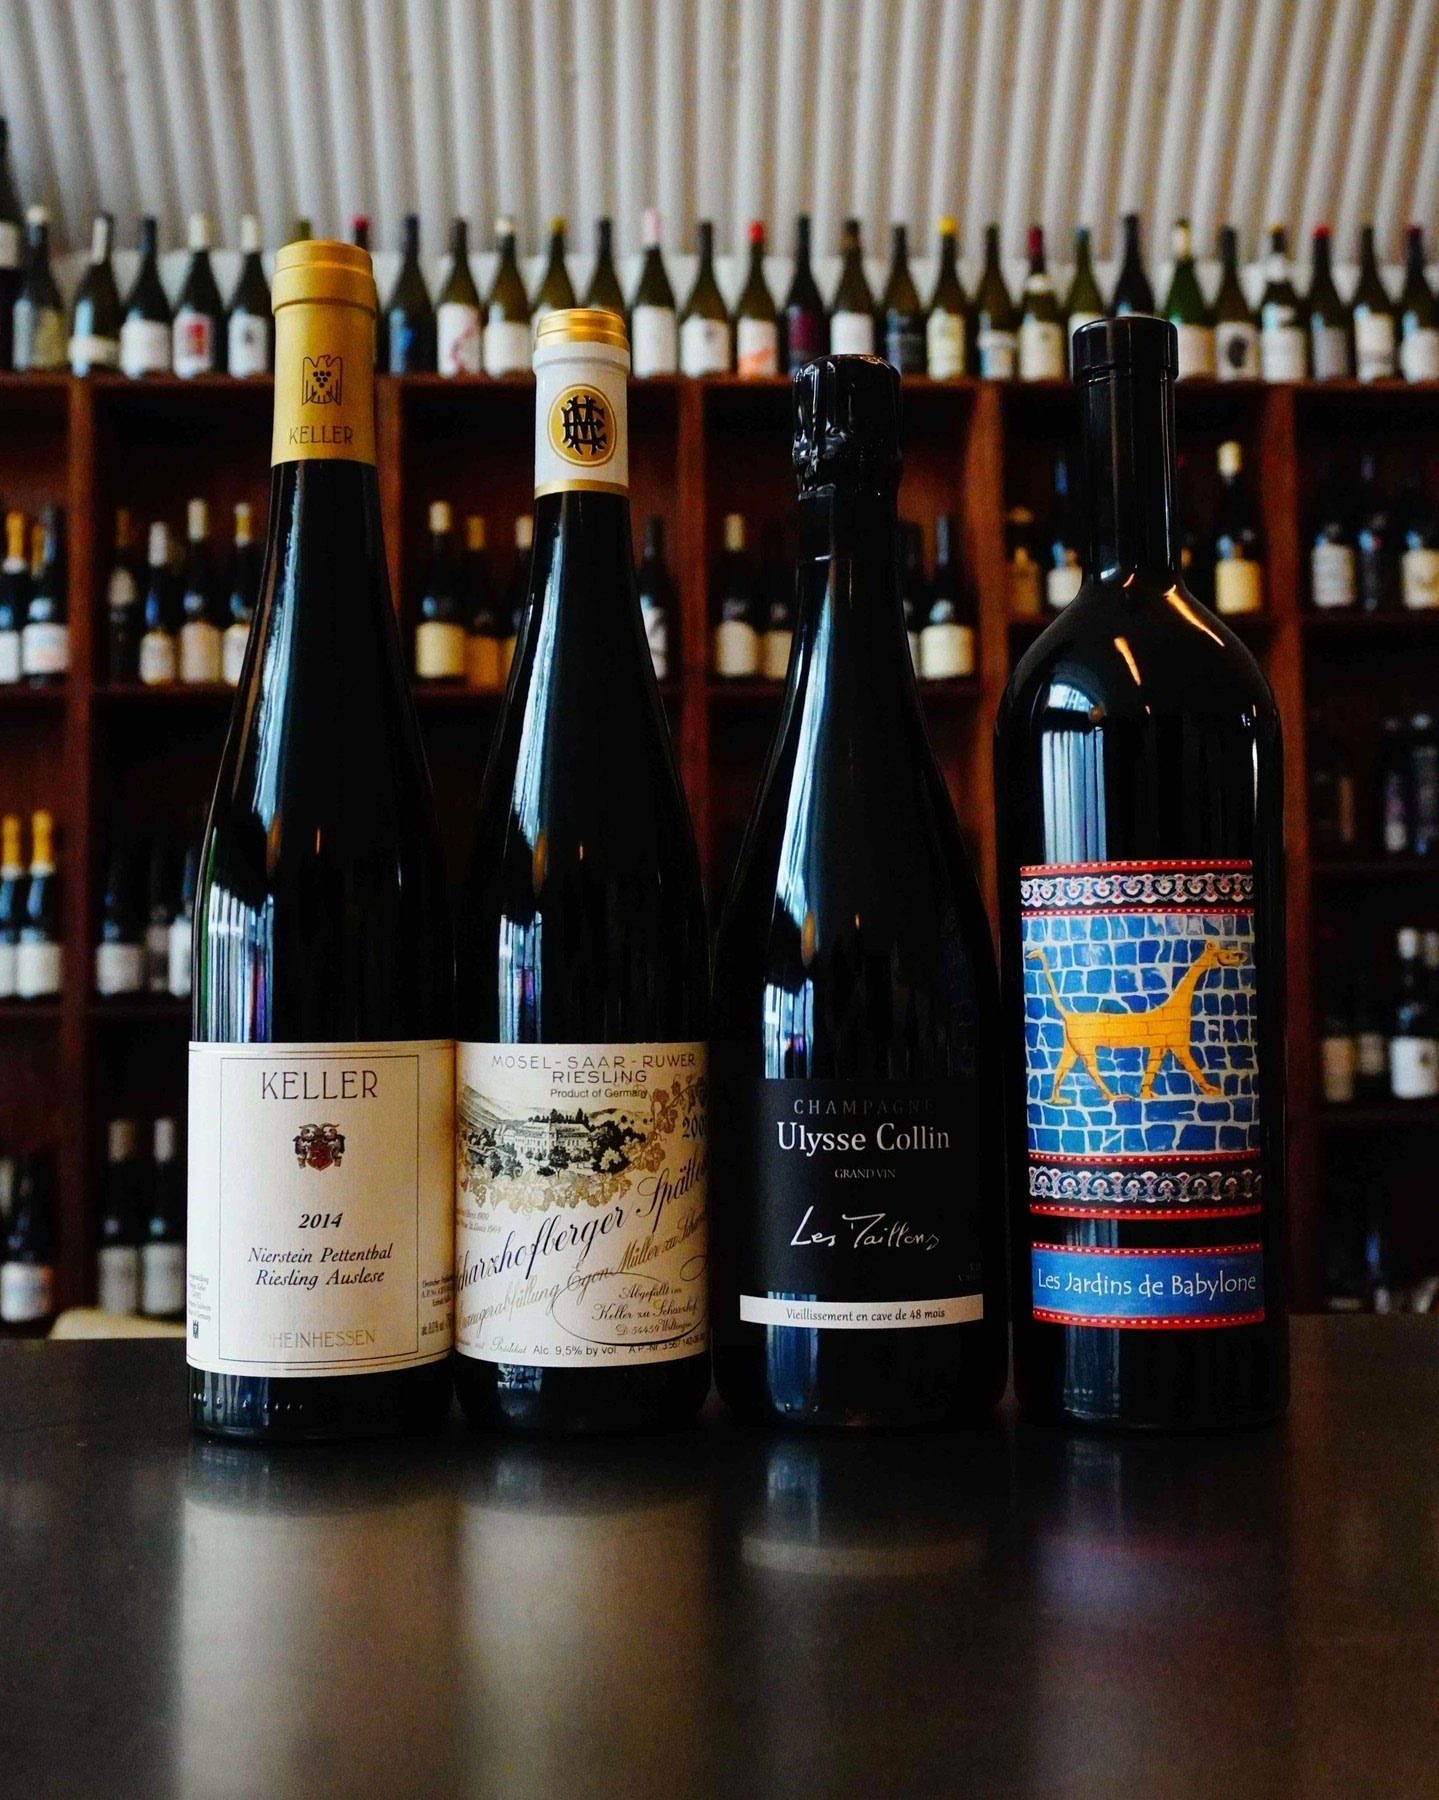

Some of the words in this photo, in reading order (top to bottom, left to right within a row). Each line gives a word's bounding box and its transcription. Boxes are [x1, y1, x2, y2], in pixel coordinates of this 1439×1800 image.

[288, 425, 353, 445] KELLER
[261, 1070, 378, 1100] KELLER
[552, 1070, 648, 1084] RIESLING
[550, 1088, 591, 1099] Product
[592, 1088, 602, 1099] of
[776, 1120, 867, 1157] Ulysse
[875, 1122, 951, 1151] Collin
[834, 1168, 875, 1179] GRAND
[876, 1168, 897, 1179] VIN
[298, 1212, 343, 1230] 2014
[790, 1205, 837, 1247] Les
[248, 1246, 313, 1264] Nierstein
[319, 1242, 393, 1264] Pettenthal
[255, 1267, 319, 1290] Riesling
[325, 1267, 385, 1287] Auslese
[1037, 1268, 1061, 1290] Les
[1065, 1271, 1133, 1296] Jardins
[1137, 1273, 1164, 1298] de
[1171, 1269, 1257, 1301] Babylone
[591, 1300, 633, 1322] Keller
[785, 1308, 854, 1322] Vieillissement
[856, 1313, 869, 1321] en
[871, 1313, 894, 1321] cave
[895, 1309, 908, 1320] de
[909, 1309, 922, 1320] 48
[924, 1309, 946, 1319] mois
[532, 1345, 549, 1355] Alc
[586, 1346, 598, 1358] by
